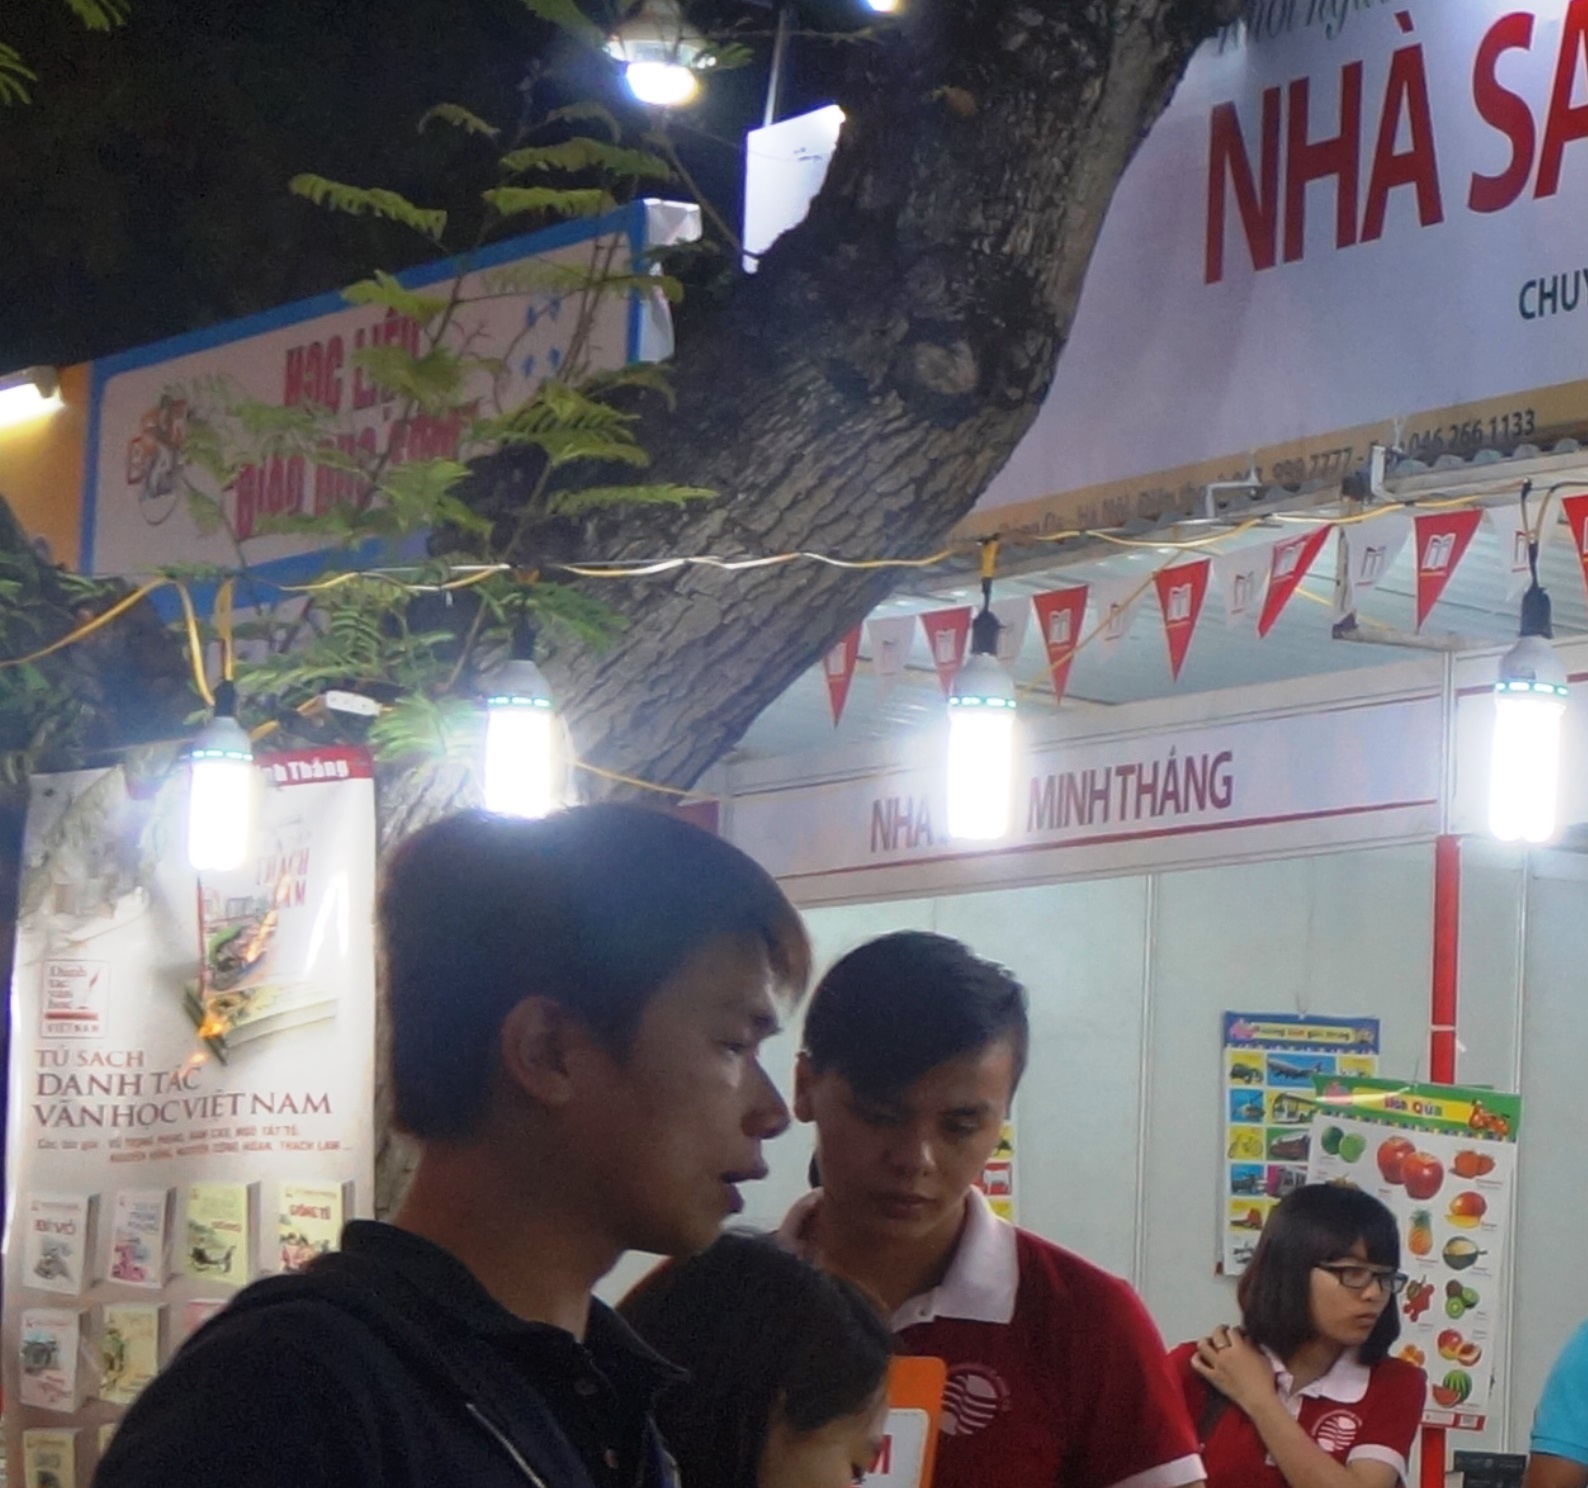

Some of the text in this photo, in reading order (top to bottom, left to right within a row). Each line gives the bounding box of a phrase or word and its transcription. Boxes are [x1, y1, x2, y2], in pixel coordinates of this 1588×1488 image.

[1204, 10, 1444, 285] NHÀ
[36, 1071, 143, 1098] DANH
[250, 1092, 332, 1117] NAM
